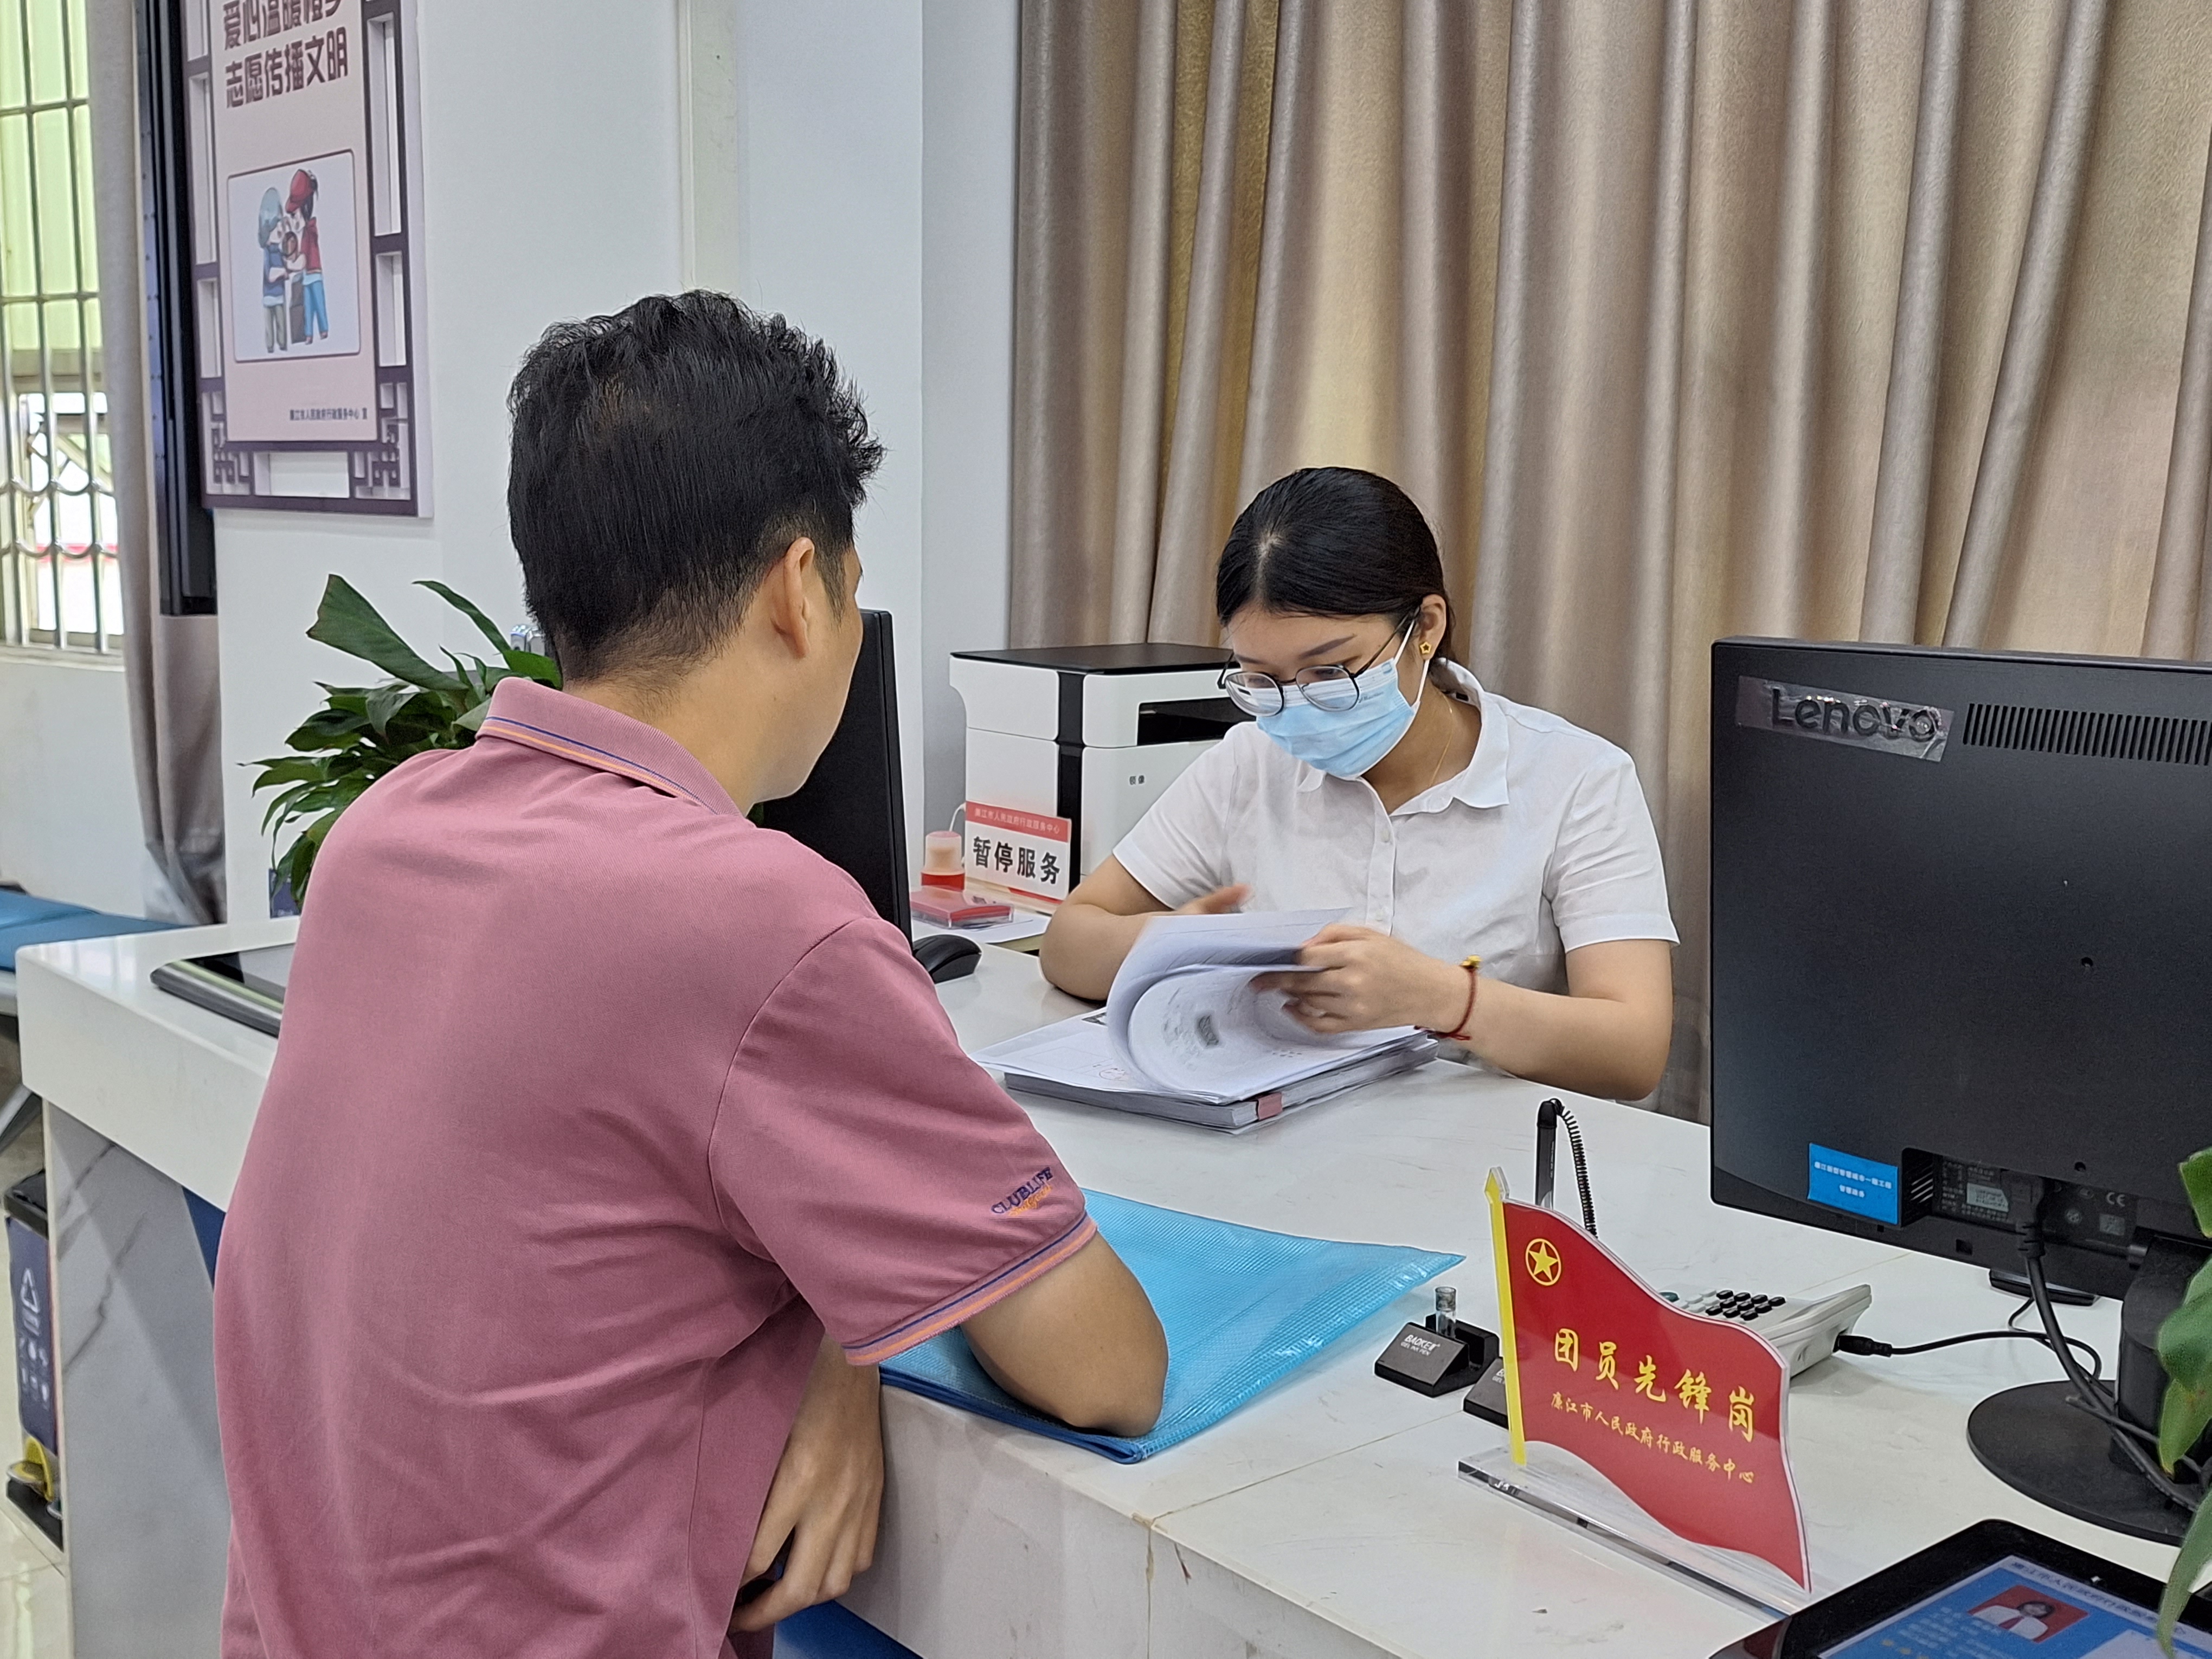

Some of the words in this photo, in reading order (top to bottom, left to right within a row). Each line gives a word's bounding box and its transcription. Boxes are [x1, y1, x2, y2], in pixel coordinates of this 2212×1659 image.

[226, 27, 348, 108] 志愿传播文明
[1771, 687, 1941, 743] Lenovo
[973, 836, 1060, 885] 暂停服务
[991, 1166, 1053, 1213] CLUBLIFE
[1554, 1328, 1755, 1443] 团员先锋岗
[1551, 1391, 1756, 1484] 廉江市人民政府行政服务中心
